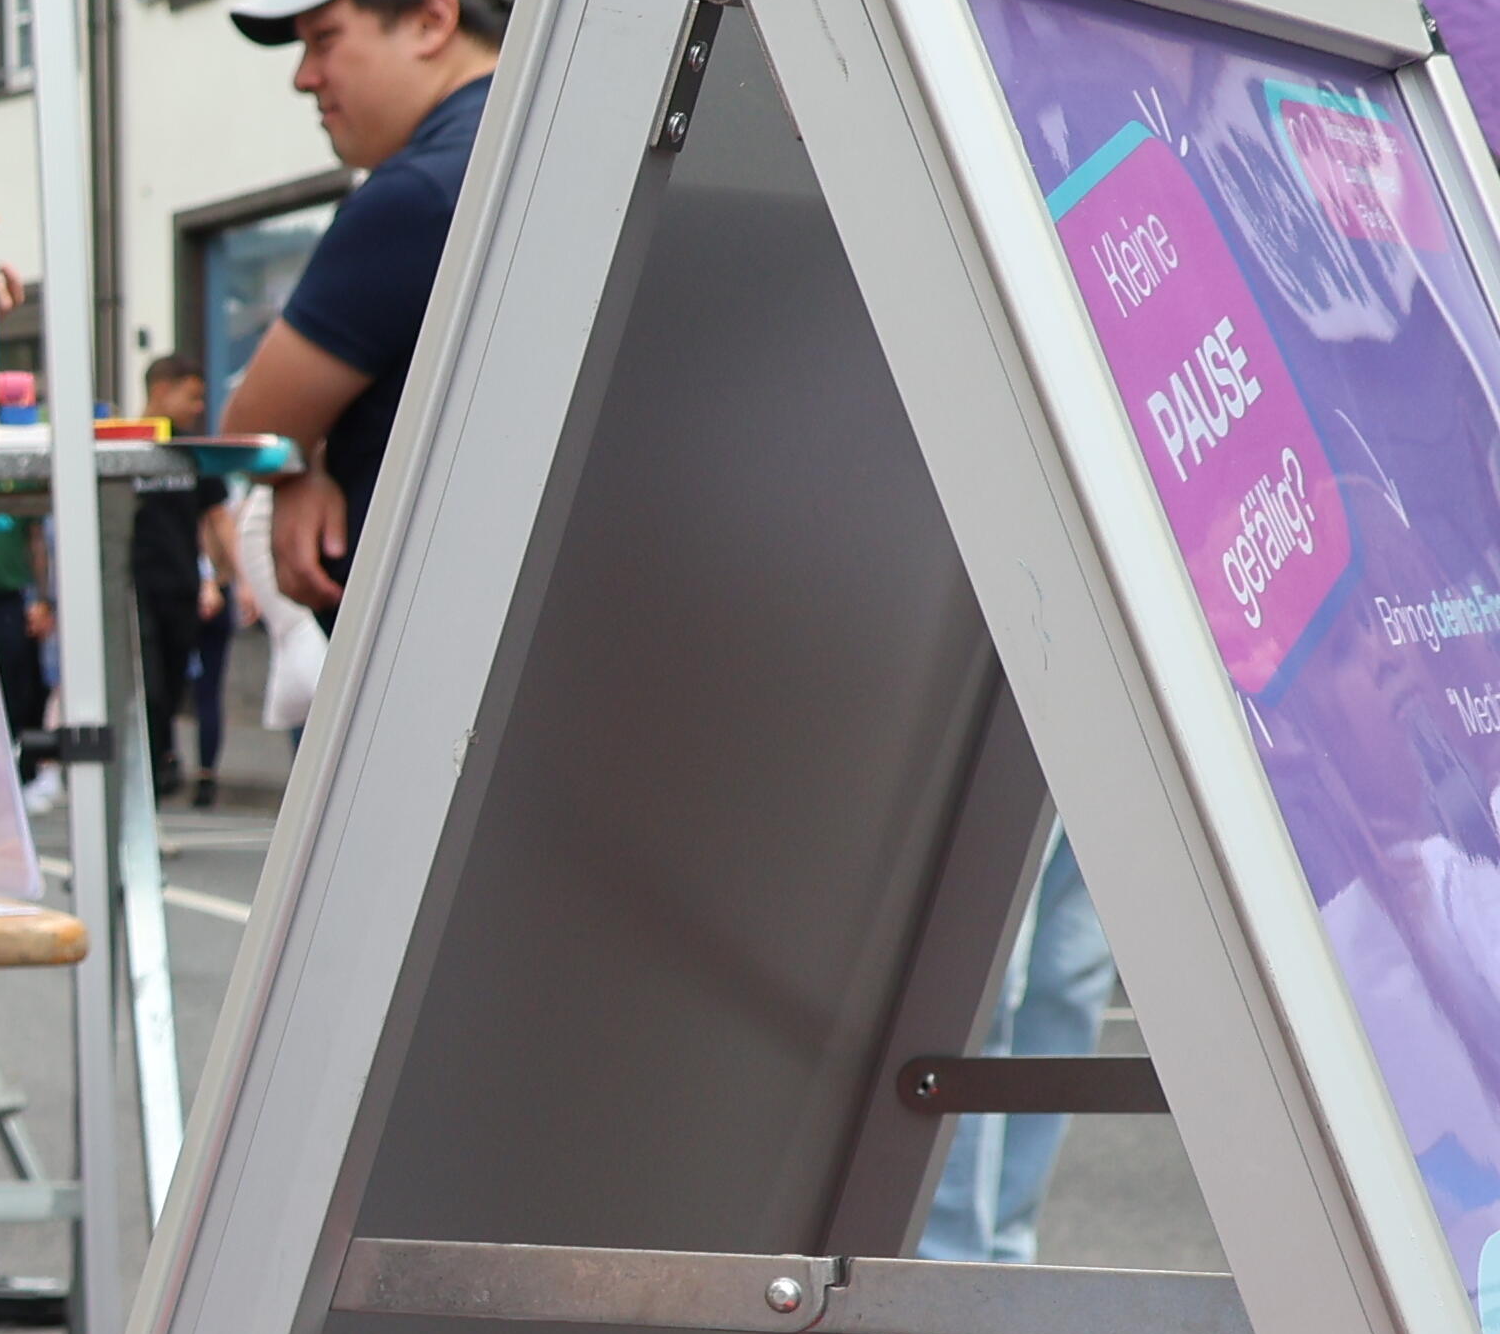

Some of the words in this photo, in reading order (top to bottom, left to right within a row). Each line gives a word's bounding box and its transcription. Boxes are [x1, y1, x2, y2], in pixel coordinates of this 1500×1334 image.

[1092, 213, 1178, 318] Kleine
[1147, 316, 1262, 482] PAUSE
[1222, 447, 1316, 628] gefällig?
[1374, 595, 1441, 652] Bring
